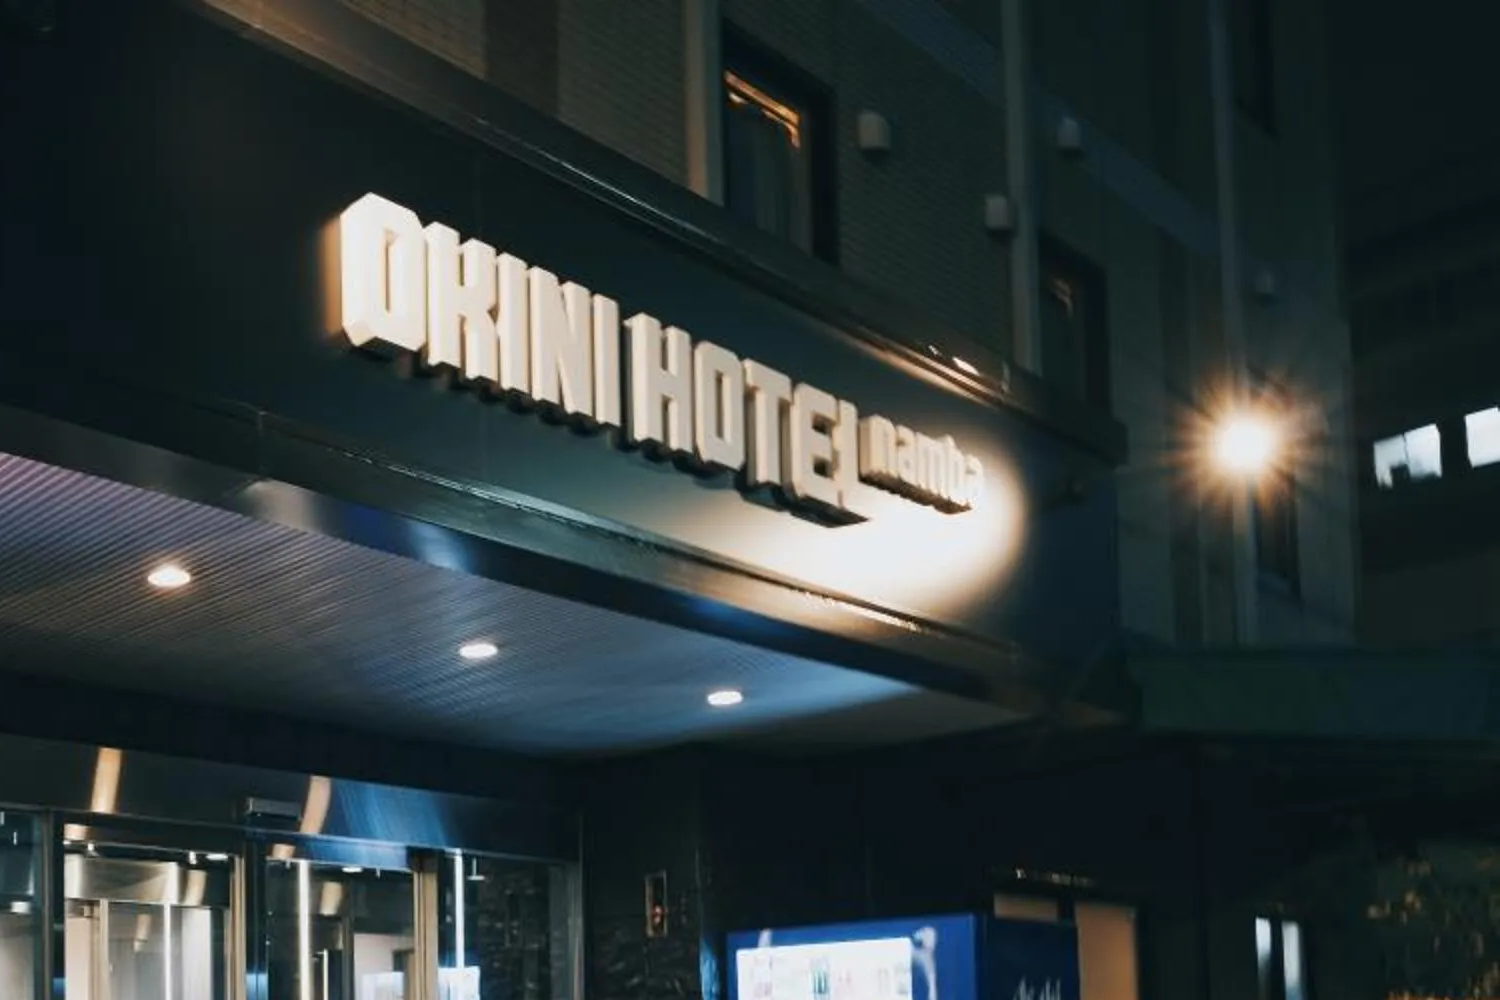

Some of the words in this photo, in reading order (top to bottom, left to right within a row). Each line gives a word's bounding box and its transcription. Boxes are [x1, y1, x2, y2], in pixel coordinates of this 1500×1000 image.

[339, 191, 621, 427] OKINI
[624, 311, 868, 512] HOTEL
[860, 414, 985, 508] namba
